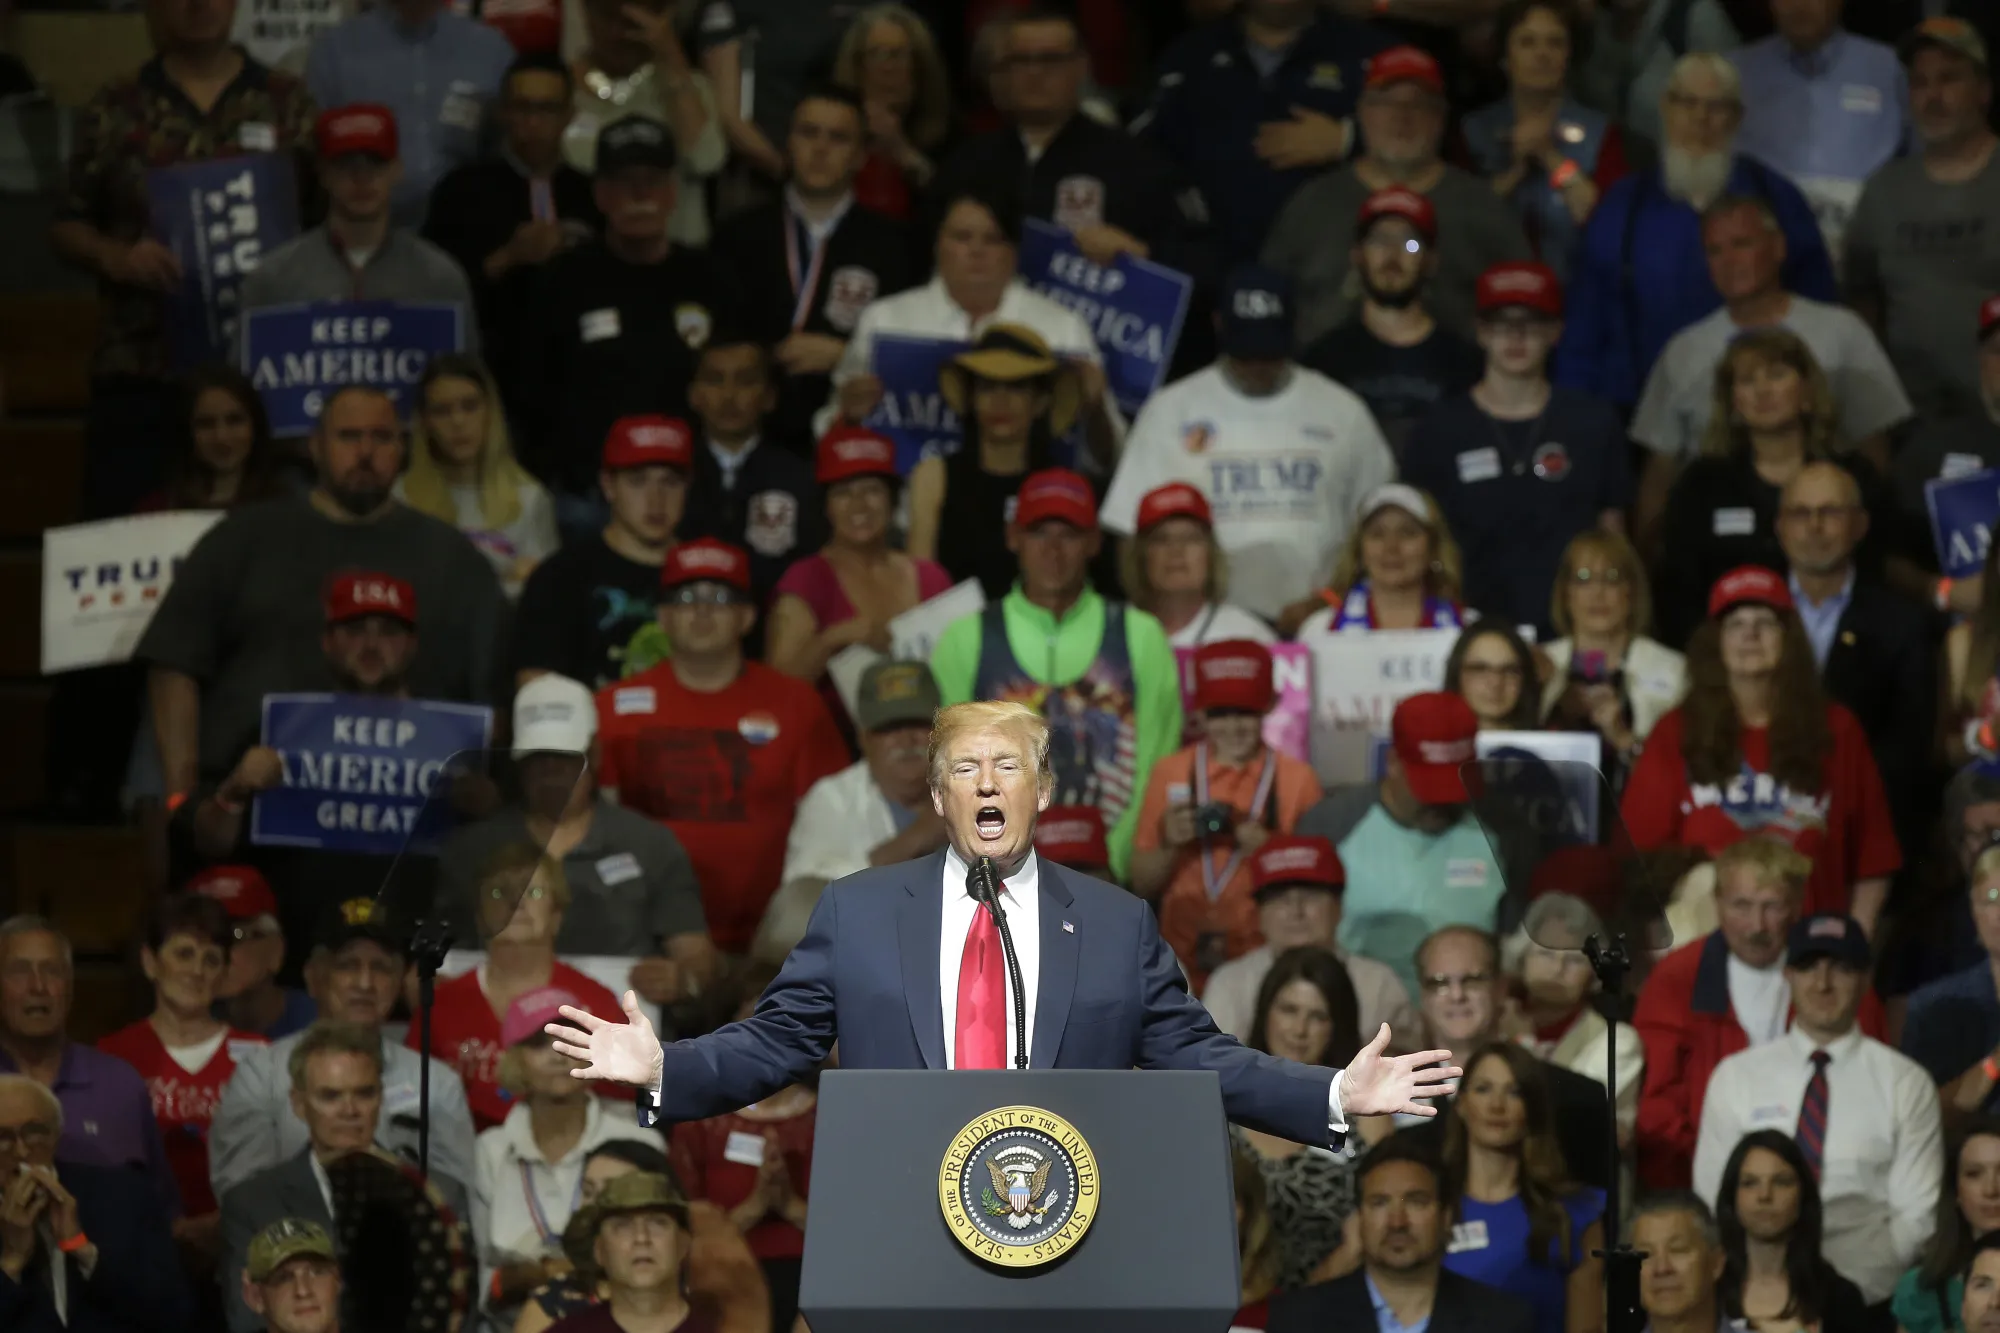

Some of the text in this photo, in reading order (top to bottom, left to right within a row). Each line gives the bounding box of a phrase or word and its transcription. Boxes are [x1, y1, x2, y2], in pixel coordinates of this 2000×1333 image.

[1049, 251, 1126, 296] KEEP
[1233, 288, 1284, 320] USA
[311, 316, 392, 344] KEEP
[252, 349, 428, 391] AMERIC
[1210, 458, 1324, 495] TRUMP
[64, 554, 180, 592] TRU
[352, 580, 402, 610] USA
[1381, 652, 1435, 682] KEE
[333, 714, 417, 748] KEEP
[277, 748, 442, 798] AMERIC
[316, 800, 421, 835] GREAT
[944, 1112, 1095, 1261] SEAL OF THE PRESIDENT OF THE UNITED STATES
